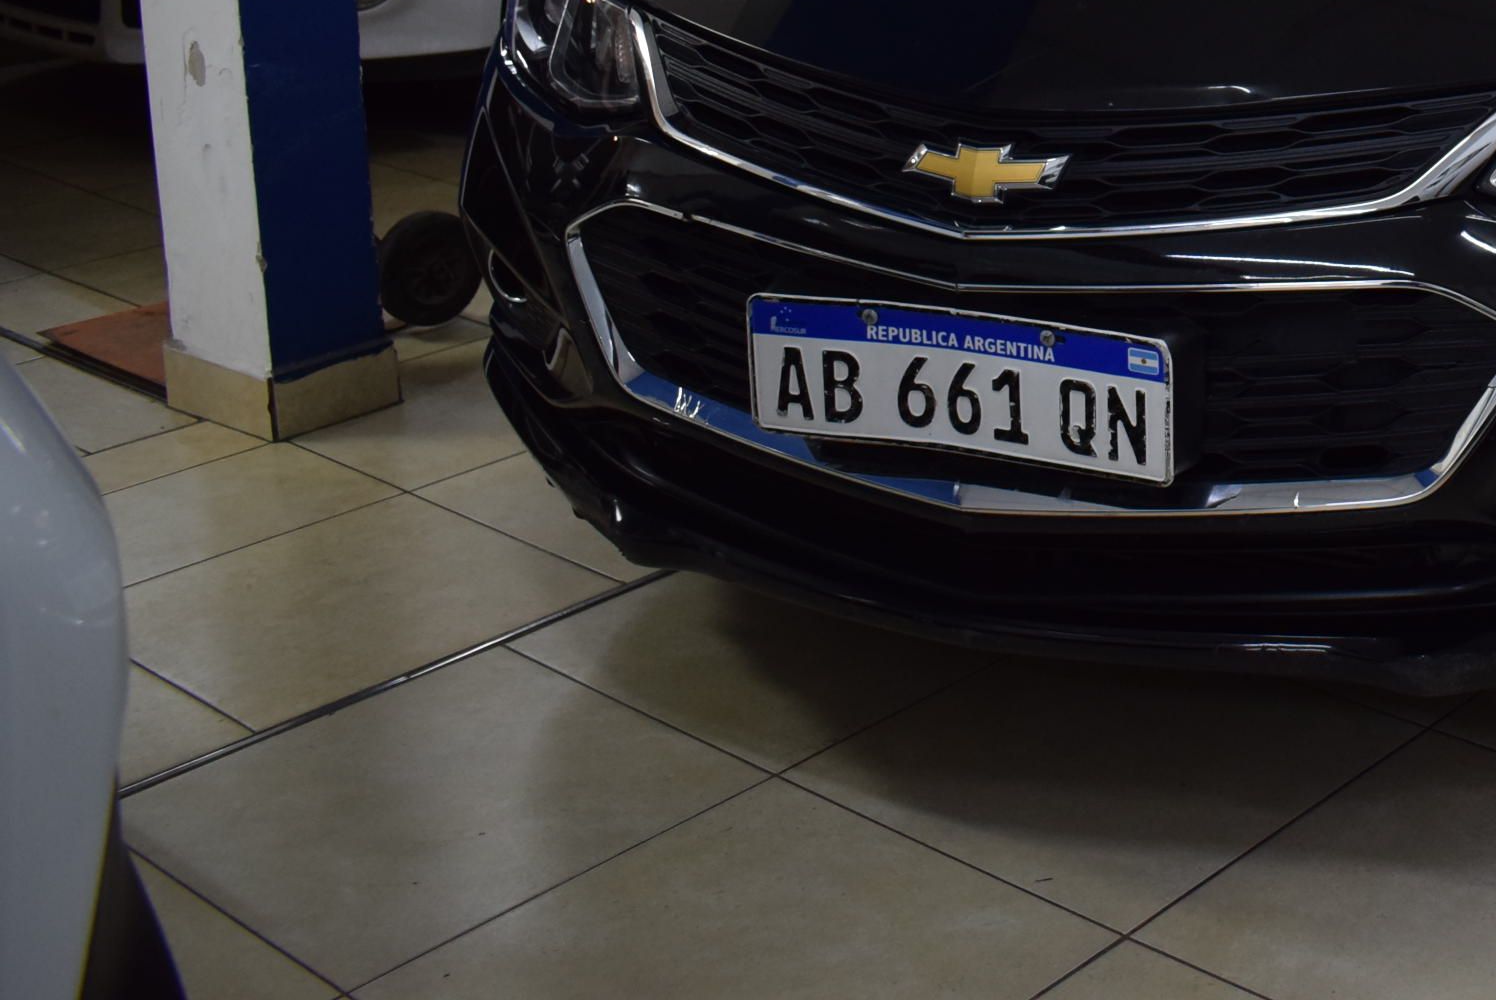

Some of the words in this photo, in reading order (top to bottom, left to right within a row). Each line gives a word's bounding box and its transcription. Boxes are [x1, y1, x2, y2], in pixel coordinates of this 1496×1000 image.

[866, 324, 959, 349] REPUBLICA
[963, 334, 1056, 363] ARGENTINA
[776, 345, 864, 424] AB
[897, 356, 1030, 446] 661
[1058, 378, 1148, 466] QN
